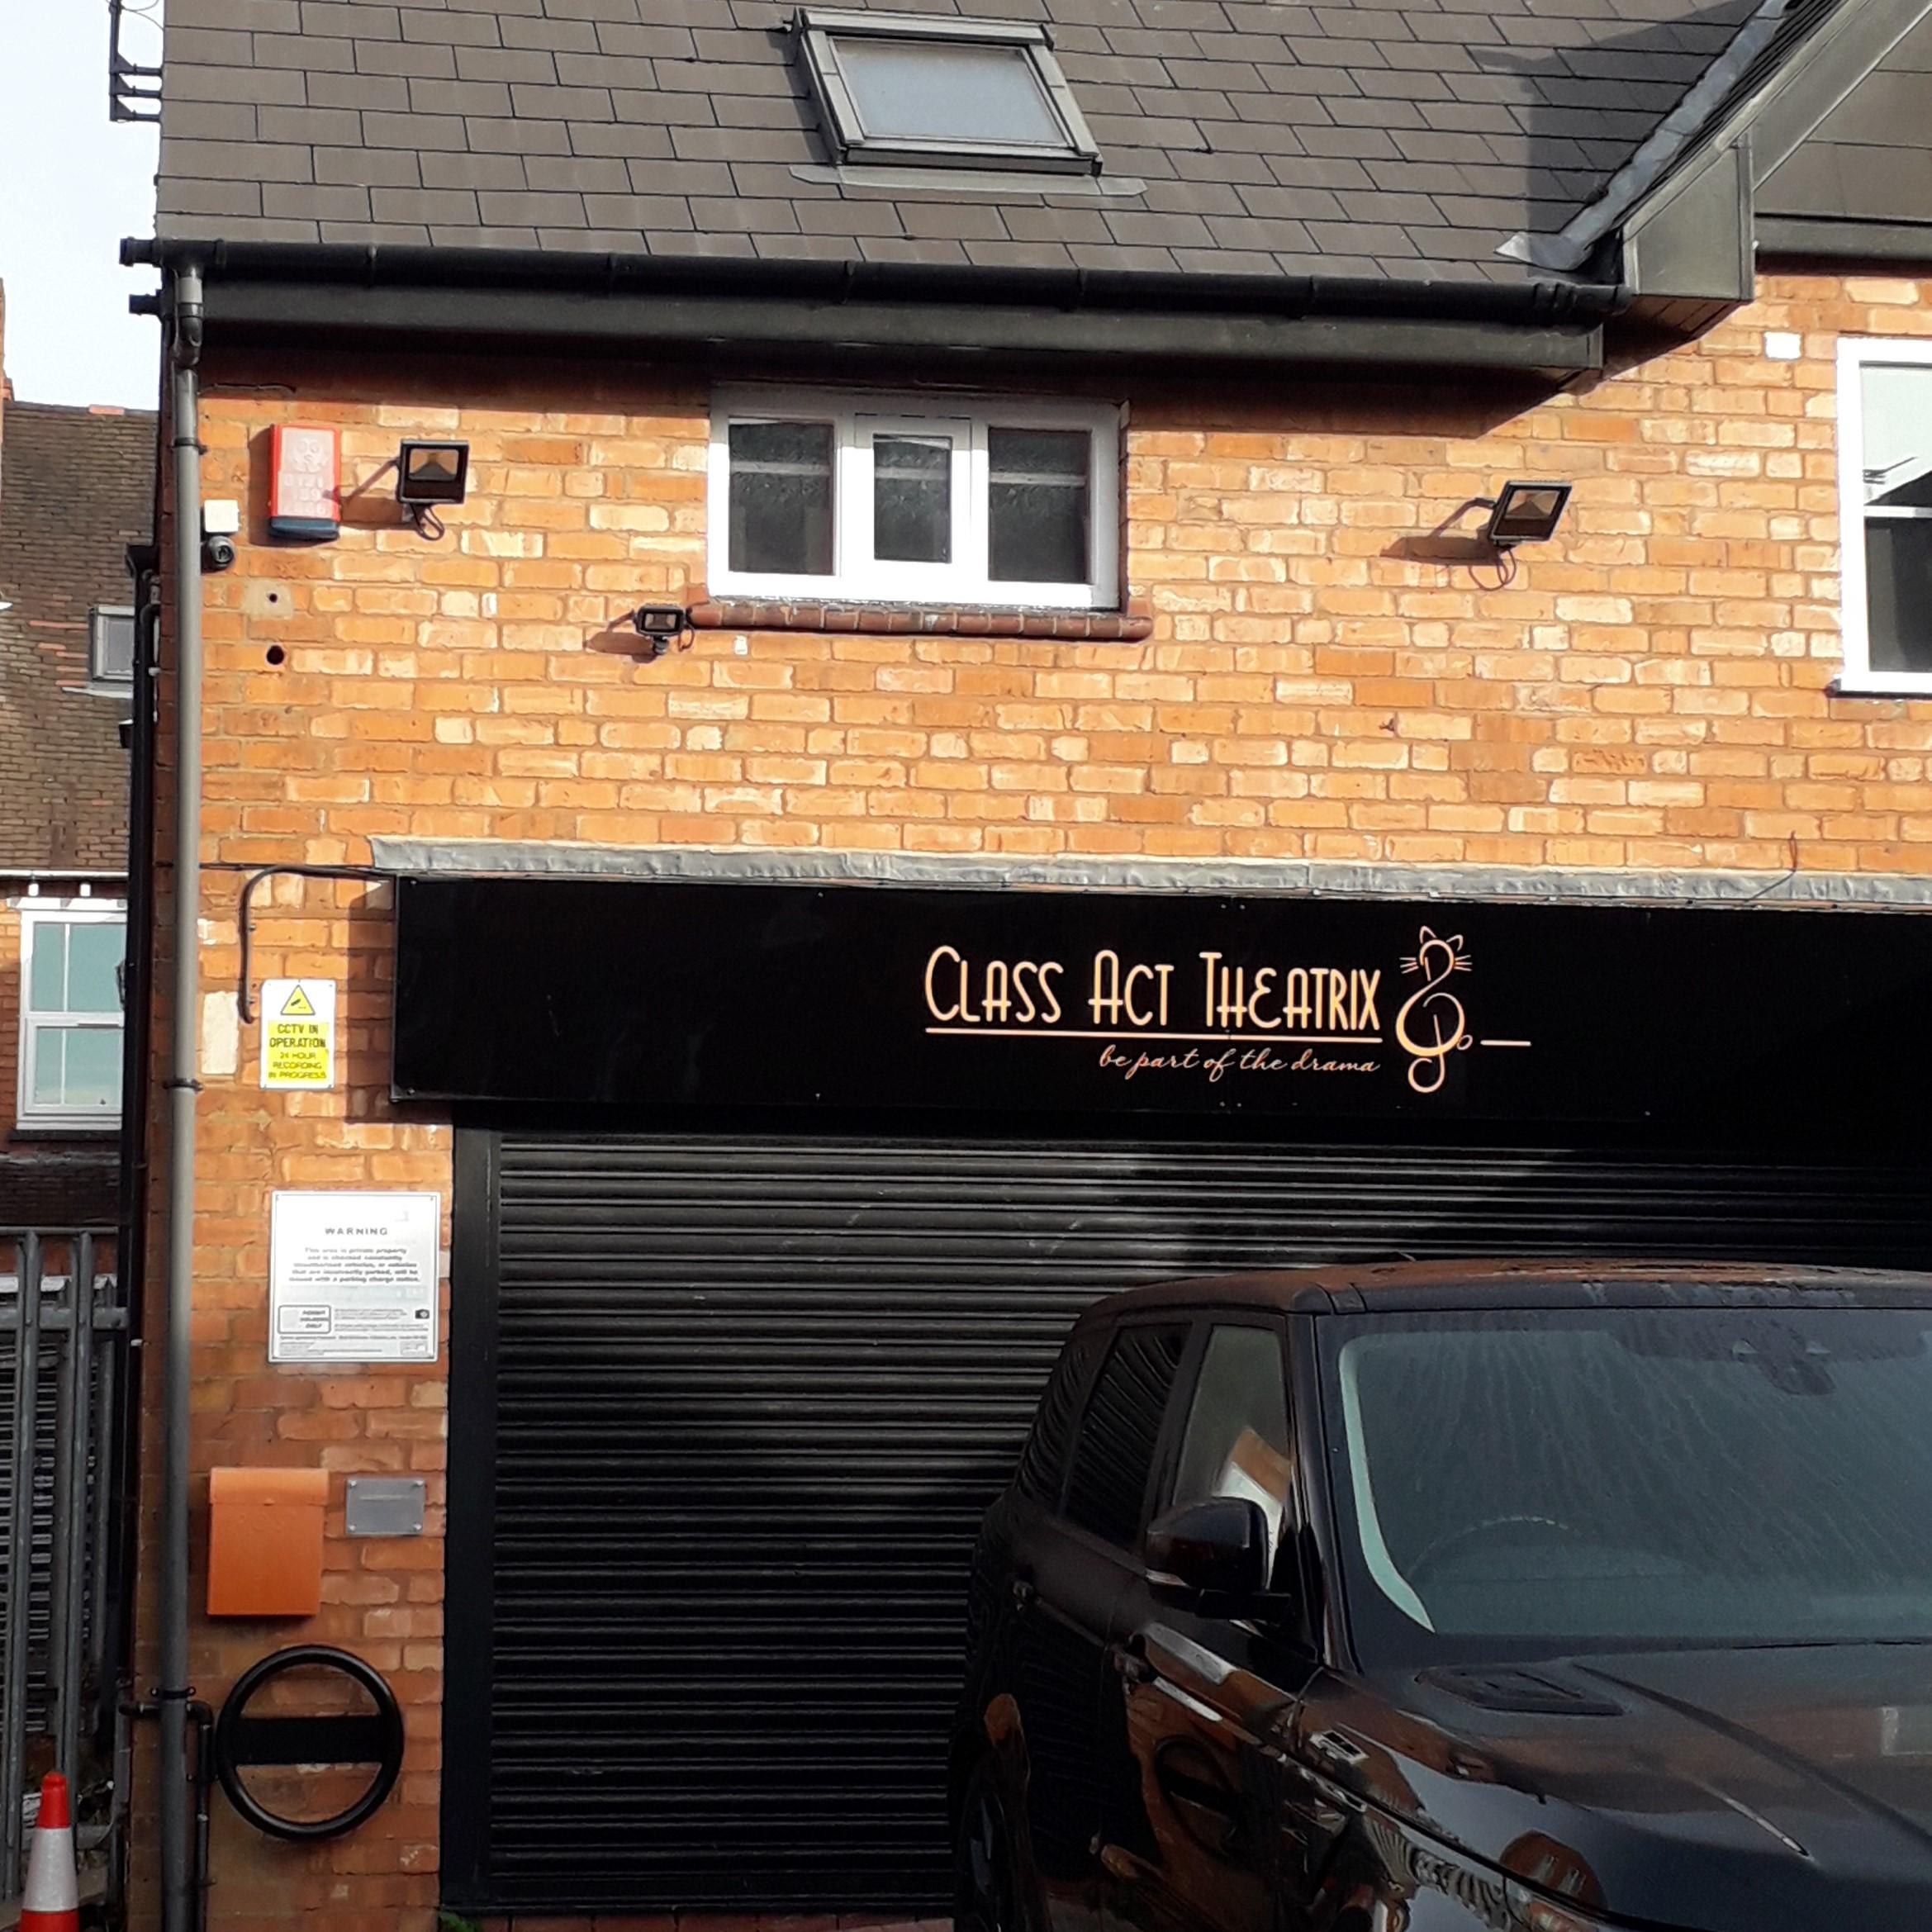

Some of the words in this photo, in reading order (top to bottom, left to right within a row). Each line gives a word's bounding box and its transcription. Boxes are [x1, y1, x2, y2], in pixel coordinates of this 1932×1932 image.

[277, 1023, 305, 1034] CCTV
[308, 1024, 319, 1034] IN
[269, 1037, 326, 1048] OPERATION
[292, 1051, 316, 1060] HOUR
[273, 1061, 322, 1070] RECORDING
[1099, 1044, 1132, 1067] be
[1124, 1048, 1200, 1080] part
[1203, 1047, 1237, 1083] of
[1240, 1047, 1288, 1070] the
[1290, 1048, 1381, 1072] drama
[325, 1227, 388, 1236] WARNING
